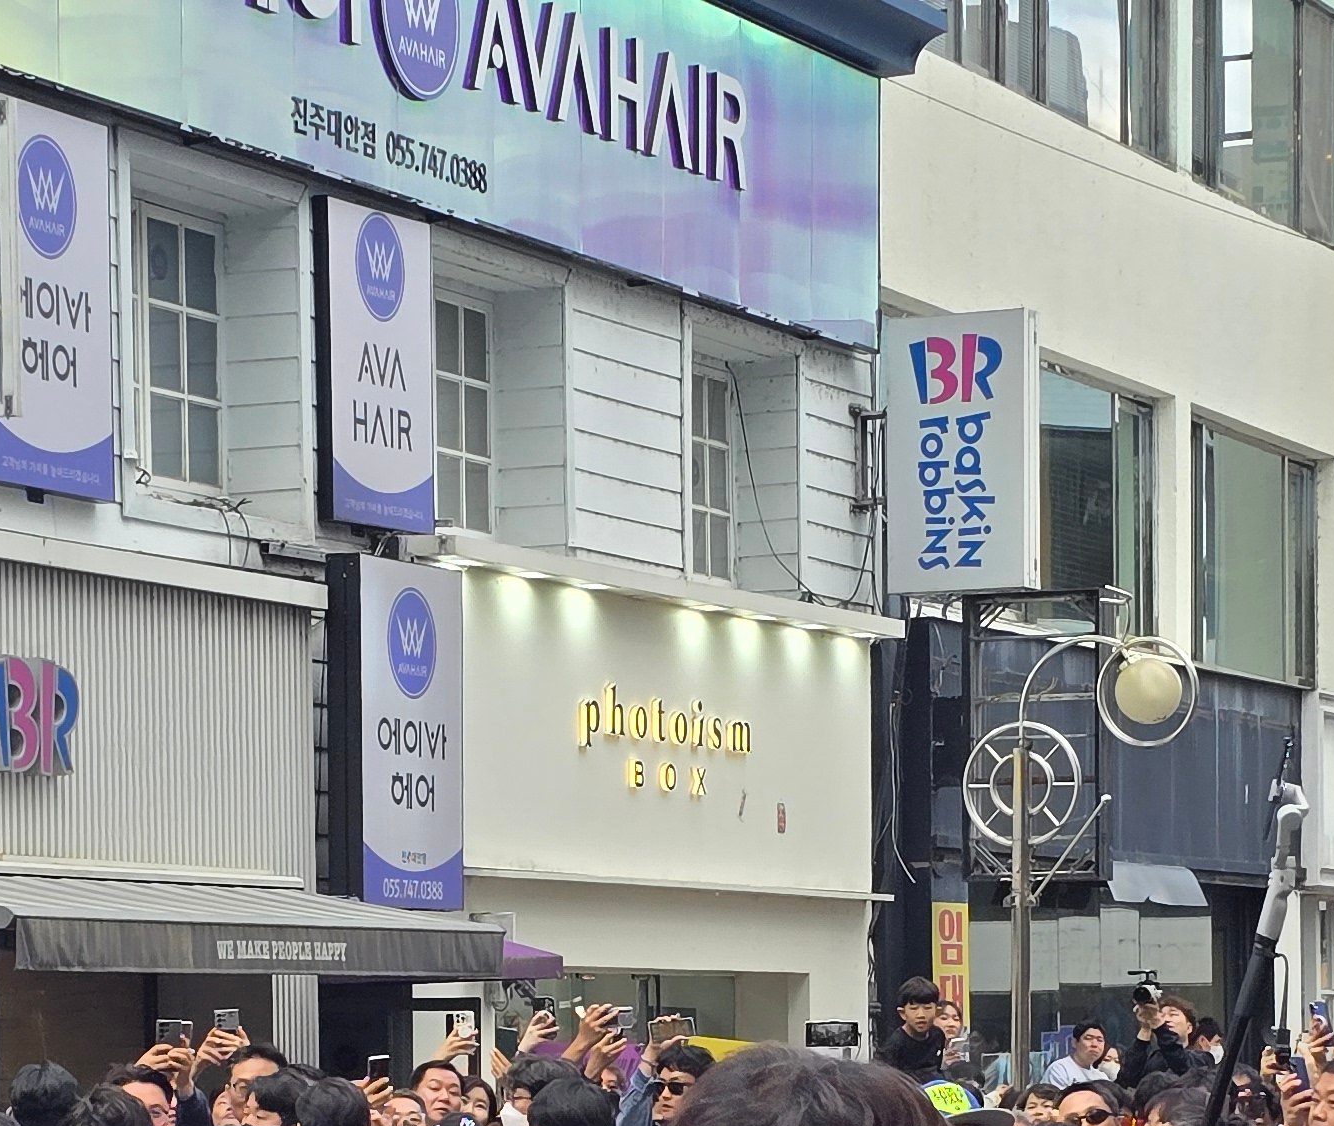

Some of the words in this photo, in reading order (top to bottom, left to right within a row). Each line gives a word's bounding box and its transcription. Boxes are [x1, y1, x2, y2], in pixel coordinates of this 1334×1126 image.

[398, 35, 446, 69] AVAHAIR
[467, 0, 747, 190] AVAHAIR
[291, 96, 377, 160] 진주대안점
[385, 130, 488, 194] 055.747.0388
[21, 337, 77, 388] 헤어
[357, 341, 406, 392] AVA
[909, 333, 1003, 405] BR
[353, 399, 412, 452] HAIR
[917, 415, 955, 571] robbins
[953, 411, 996, 568] baskin
[377, 717, 447, 761] 에이바
[579, 681, 752, 755] photoism
[391, 771, 435, 812] 헤어
[628, 758, 707, 796] BOX
[383, 878, 444, 901] 055.747.0388
[217, 940, 235, 960] WE
[237, 940, 270, 960] MAKE
[271, 940, 312, 961] PEOPLE
[313, 941, 347, 962] HAPPY
